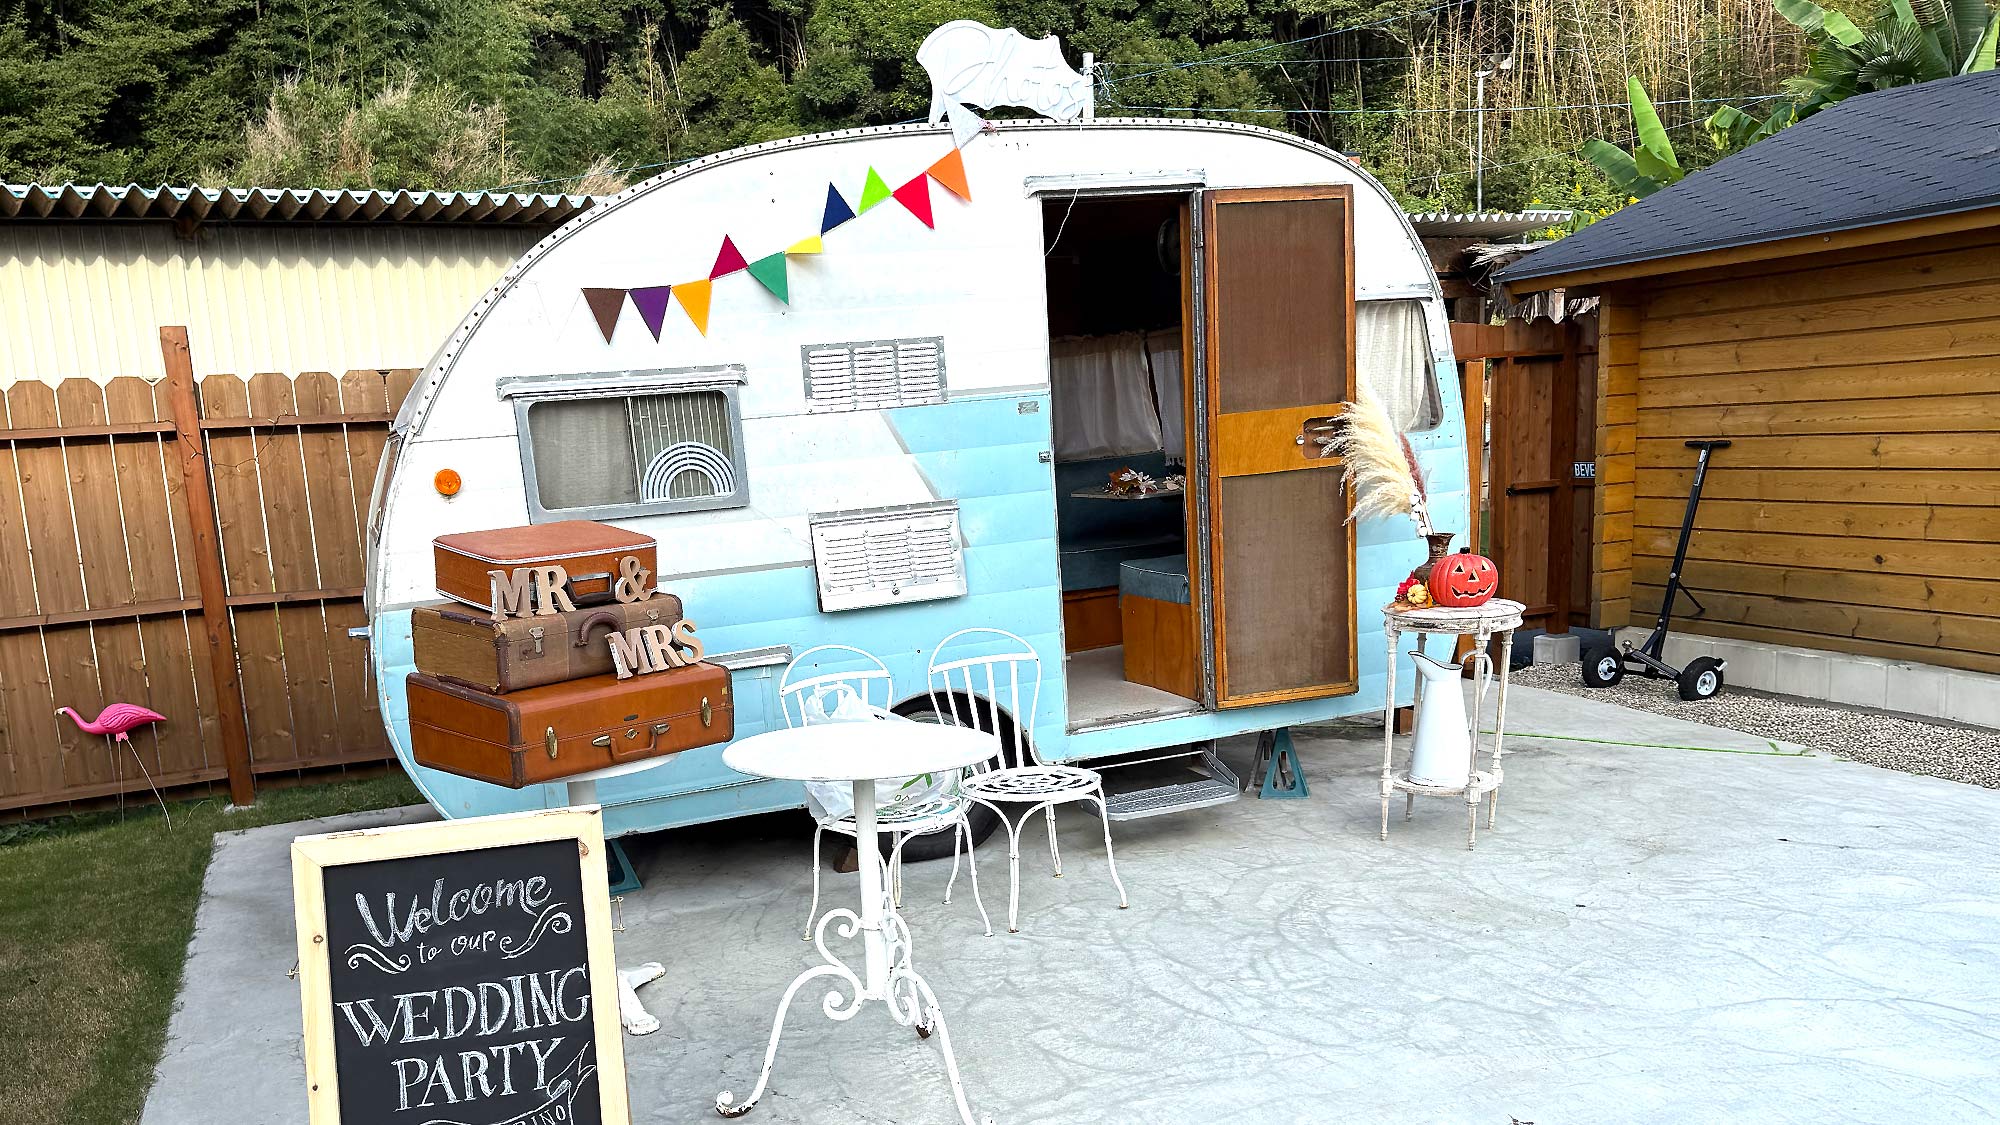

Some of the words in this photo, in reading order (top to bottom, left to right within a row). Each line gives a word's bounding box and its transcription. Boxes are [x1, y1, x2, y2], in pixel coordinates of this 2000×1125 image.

[1574, 463, 1595, 477] BEVE
[487, 565, 576, 622] MR
[615, 556, 651, 604] &
[605, 619, 704, 680] MRS
[355, 875, 552, 948] Welcome
[417, 942, 442, 964] to
[335, 963, 590, 1047] WEDDING
[391, 1036, 566, 1112] PARTY
